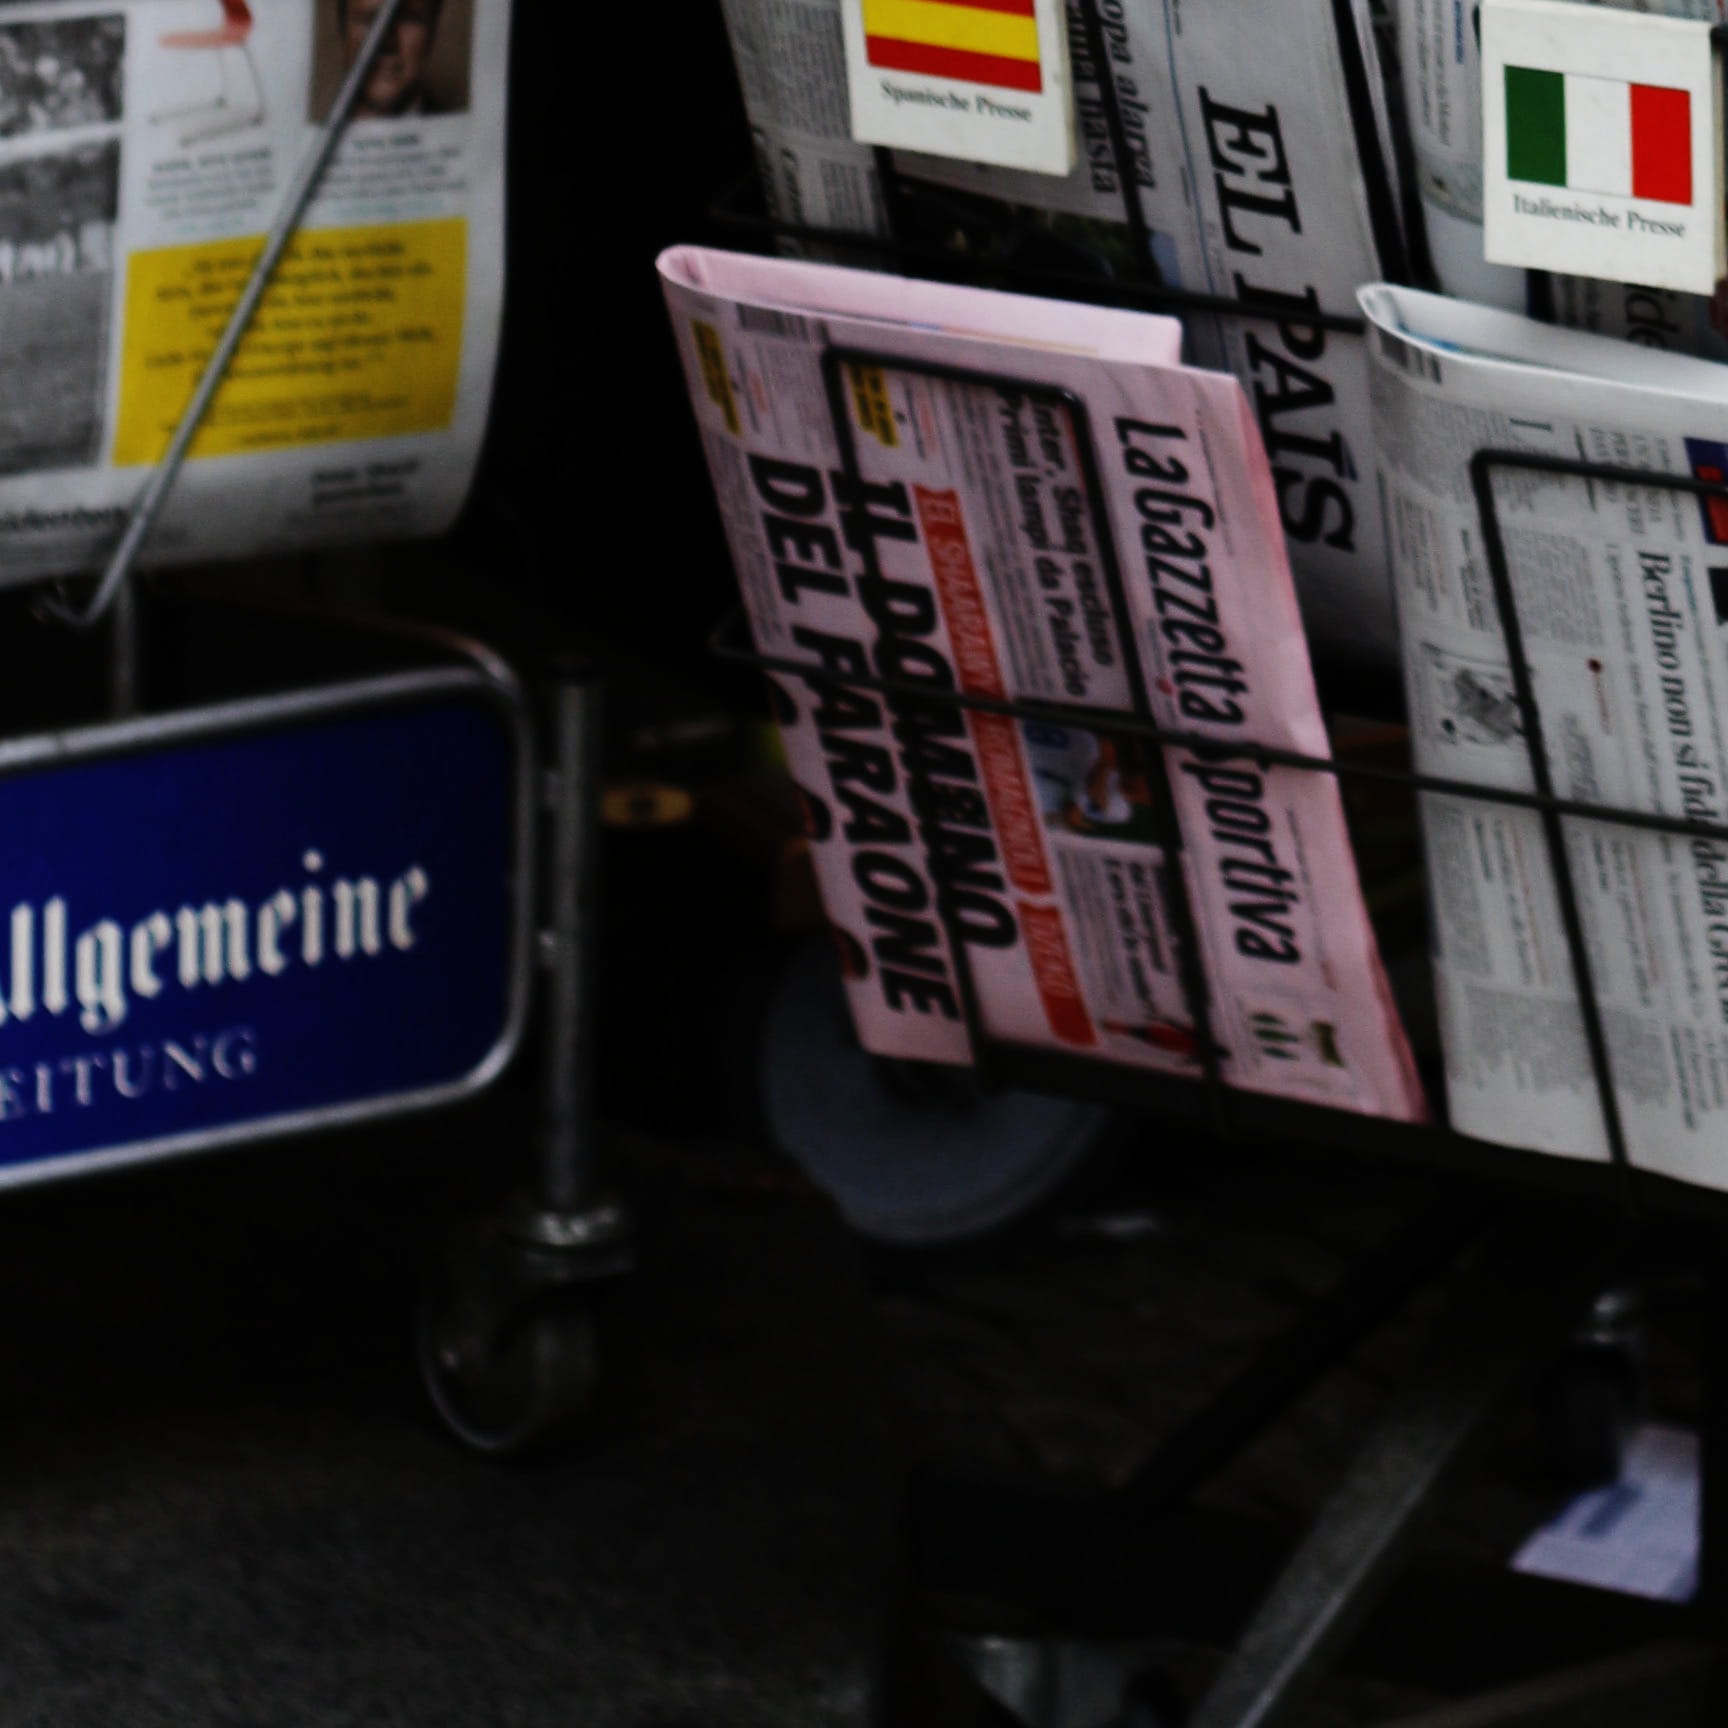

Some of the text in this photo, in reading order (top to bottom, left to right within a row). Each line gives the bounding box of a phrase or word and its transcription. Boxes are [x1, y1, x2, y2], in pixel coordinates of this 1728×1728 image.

[880, 81, 1033, 125] Spanische Presse
[1198, 84, 1304, 256] EL
[1512, 192, 1688, 240] Italienische Presse
[1033, 556, 1062, 592] da
[1635, 549, 1691, 673] Berlino
[1046, 595, 1091, 698] Palacio
[746, 454, 961, 1022] DEL FARAONE
[1659, 675, 1697, 738] non
[1673, 744, 1704, 772] si
[0, 849, 430, 1035] llgemeine
